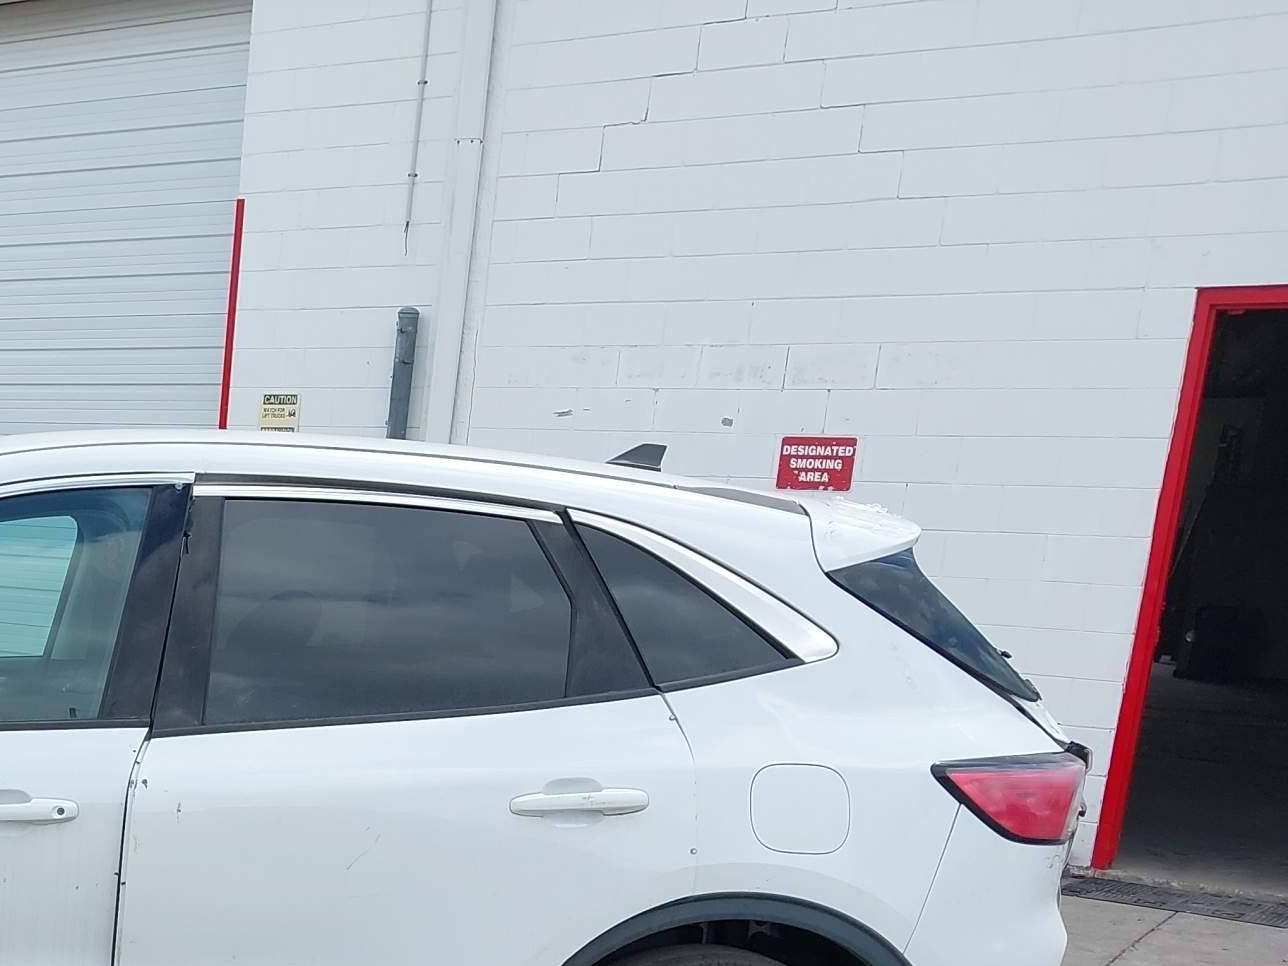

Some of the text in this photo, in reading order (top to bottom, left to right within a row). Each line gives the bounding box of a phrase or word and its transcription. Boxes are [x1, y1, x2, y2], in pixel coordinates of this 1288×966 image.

[264, 395, 297, 404] CAUTION
[782, 445, 853, 456] DESIGNATED
[789, 458, 842, 469] SMOKING
[798, 471, 829, 482] AREA
